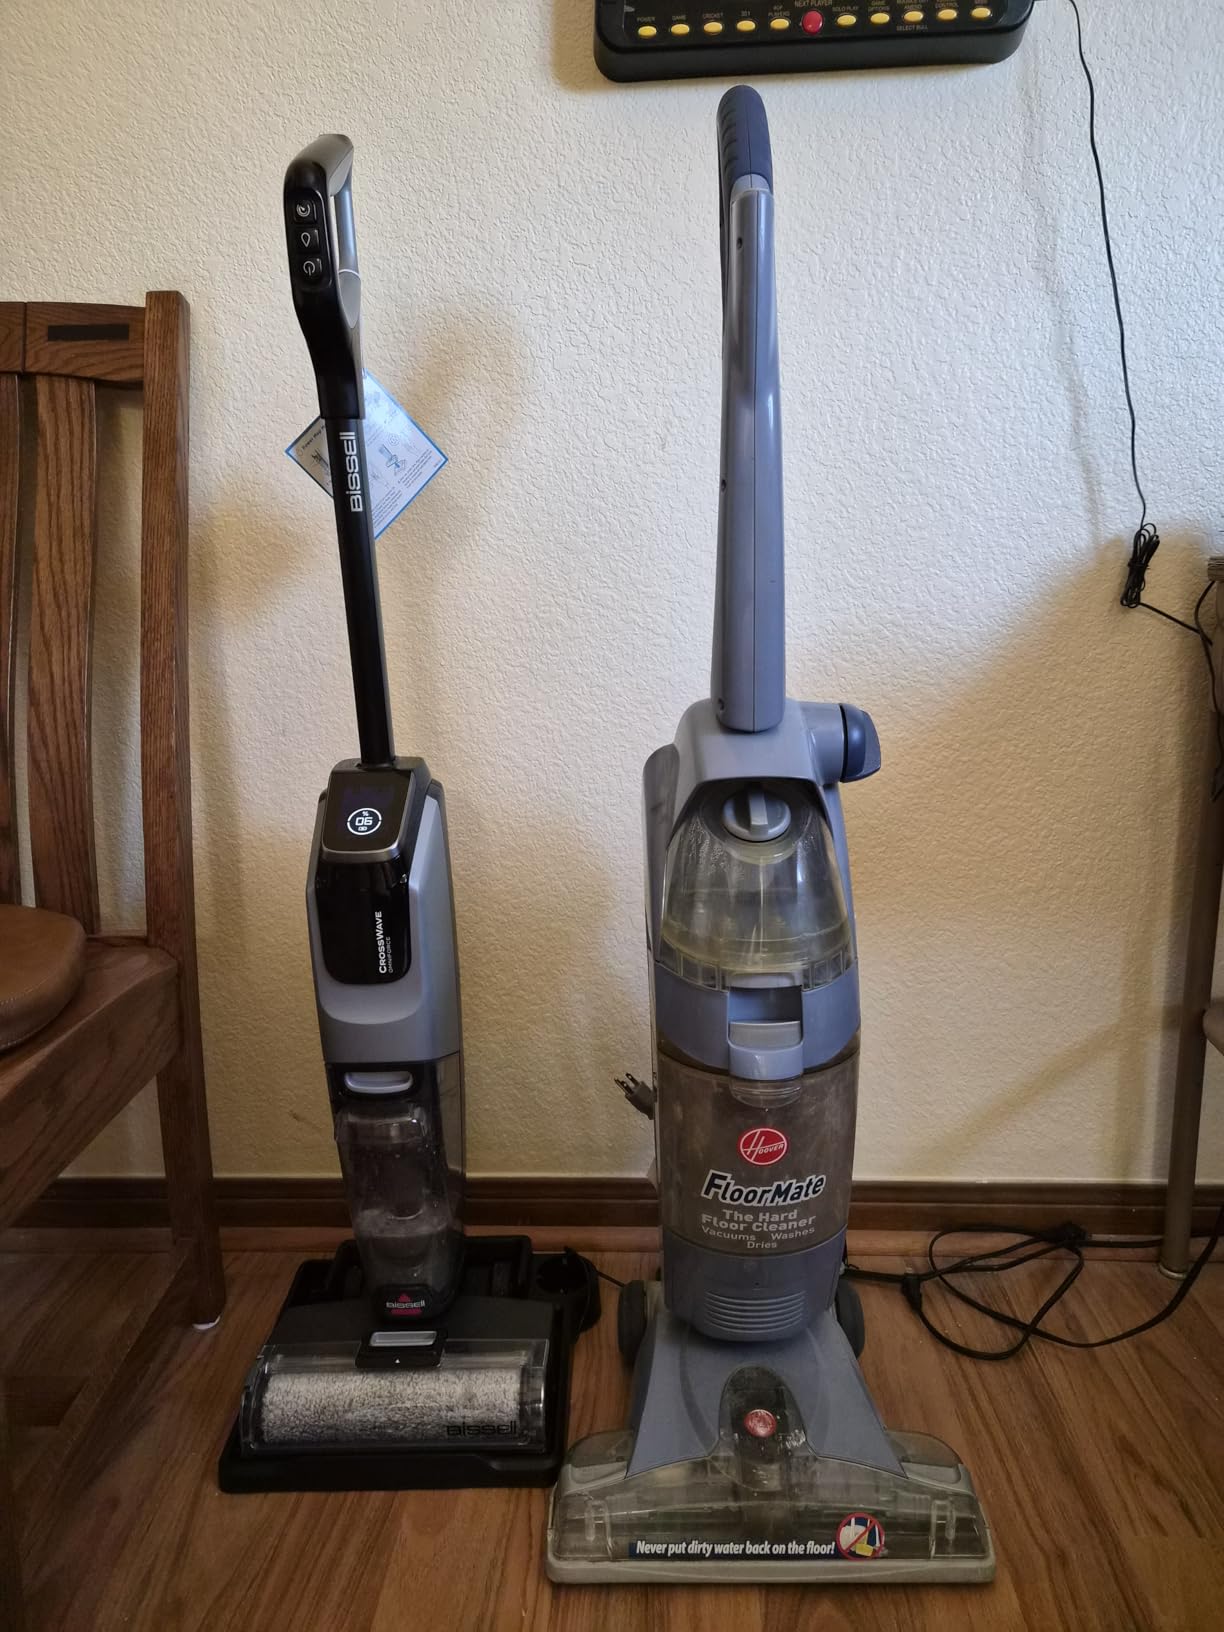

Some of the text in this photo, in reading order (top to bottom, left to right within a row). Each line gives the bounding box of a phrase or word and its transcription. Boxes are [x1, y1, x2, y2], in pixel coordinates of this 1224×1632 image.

[794, 0, 810, 8] NEXT
[375, 911, 388, 974] CROSSWAVE
[701, 1169, 827, 1207] FloorMate
[701, 1213, 816, 1232] Floor Cleaner
[722, 1209, 798, 1223] The Hard
[702, 1225, 815, 1241] Vacuums Washes
[747, 1240, 777, 1249] Dries
[636, 1540, 835, 1557] Never put dirty water back on the floor!
